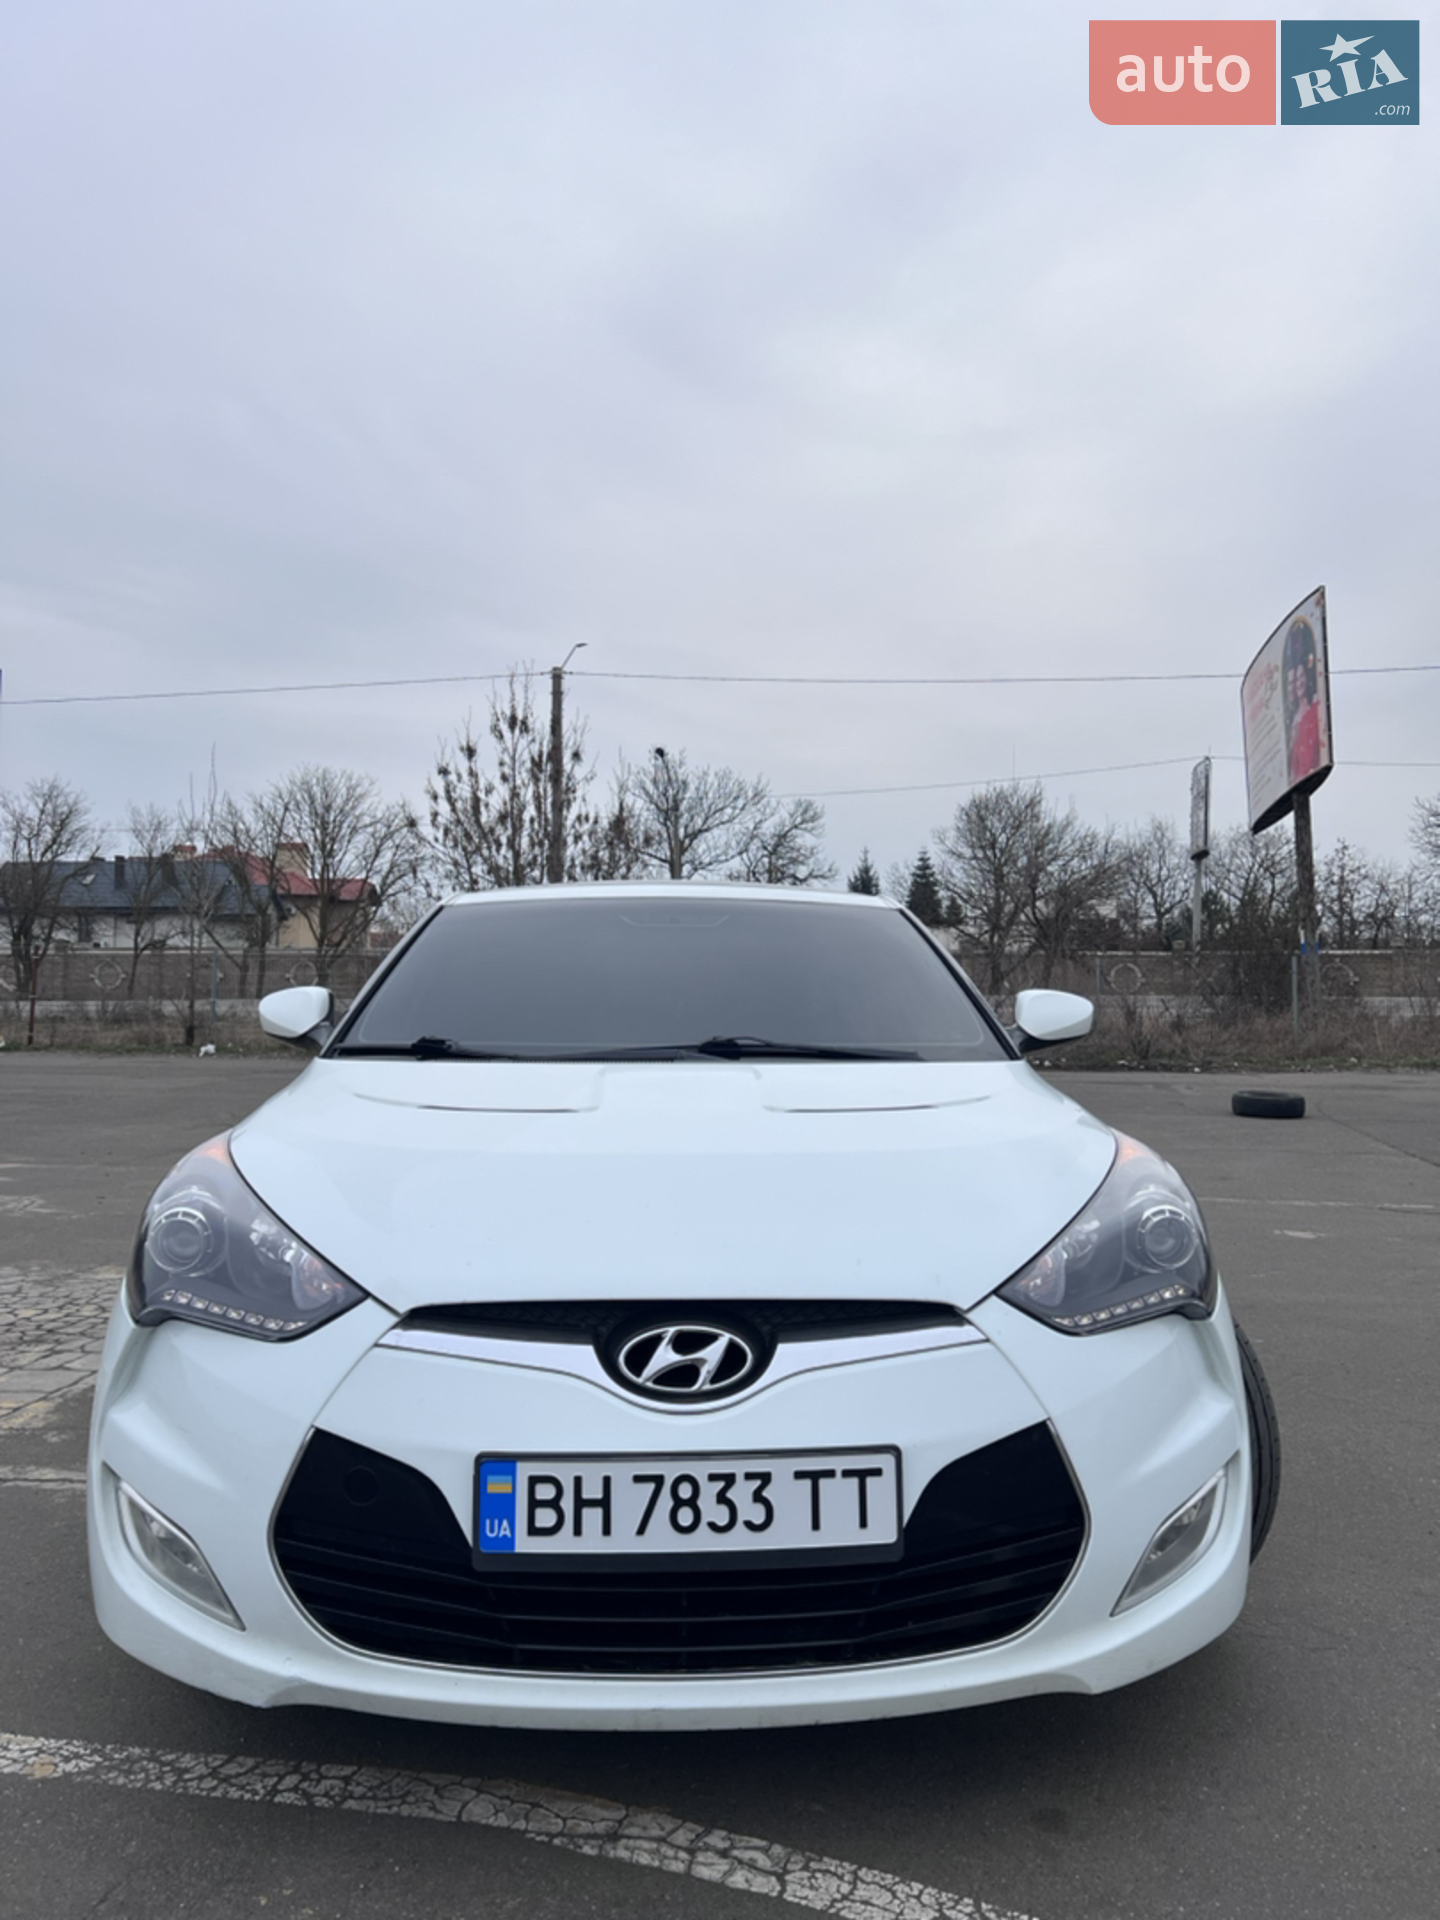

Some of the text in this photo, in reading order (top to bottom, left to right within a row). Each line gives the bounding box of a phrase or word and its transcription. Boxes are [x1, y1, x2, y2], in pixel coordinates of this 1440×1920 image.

[526, 1467, 883, 1537] BH 7833 TT
[485, 1518, 512, 1538] UA
